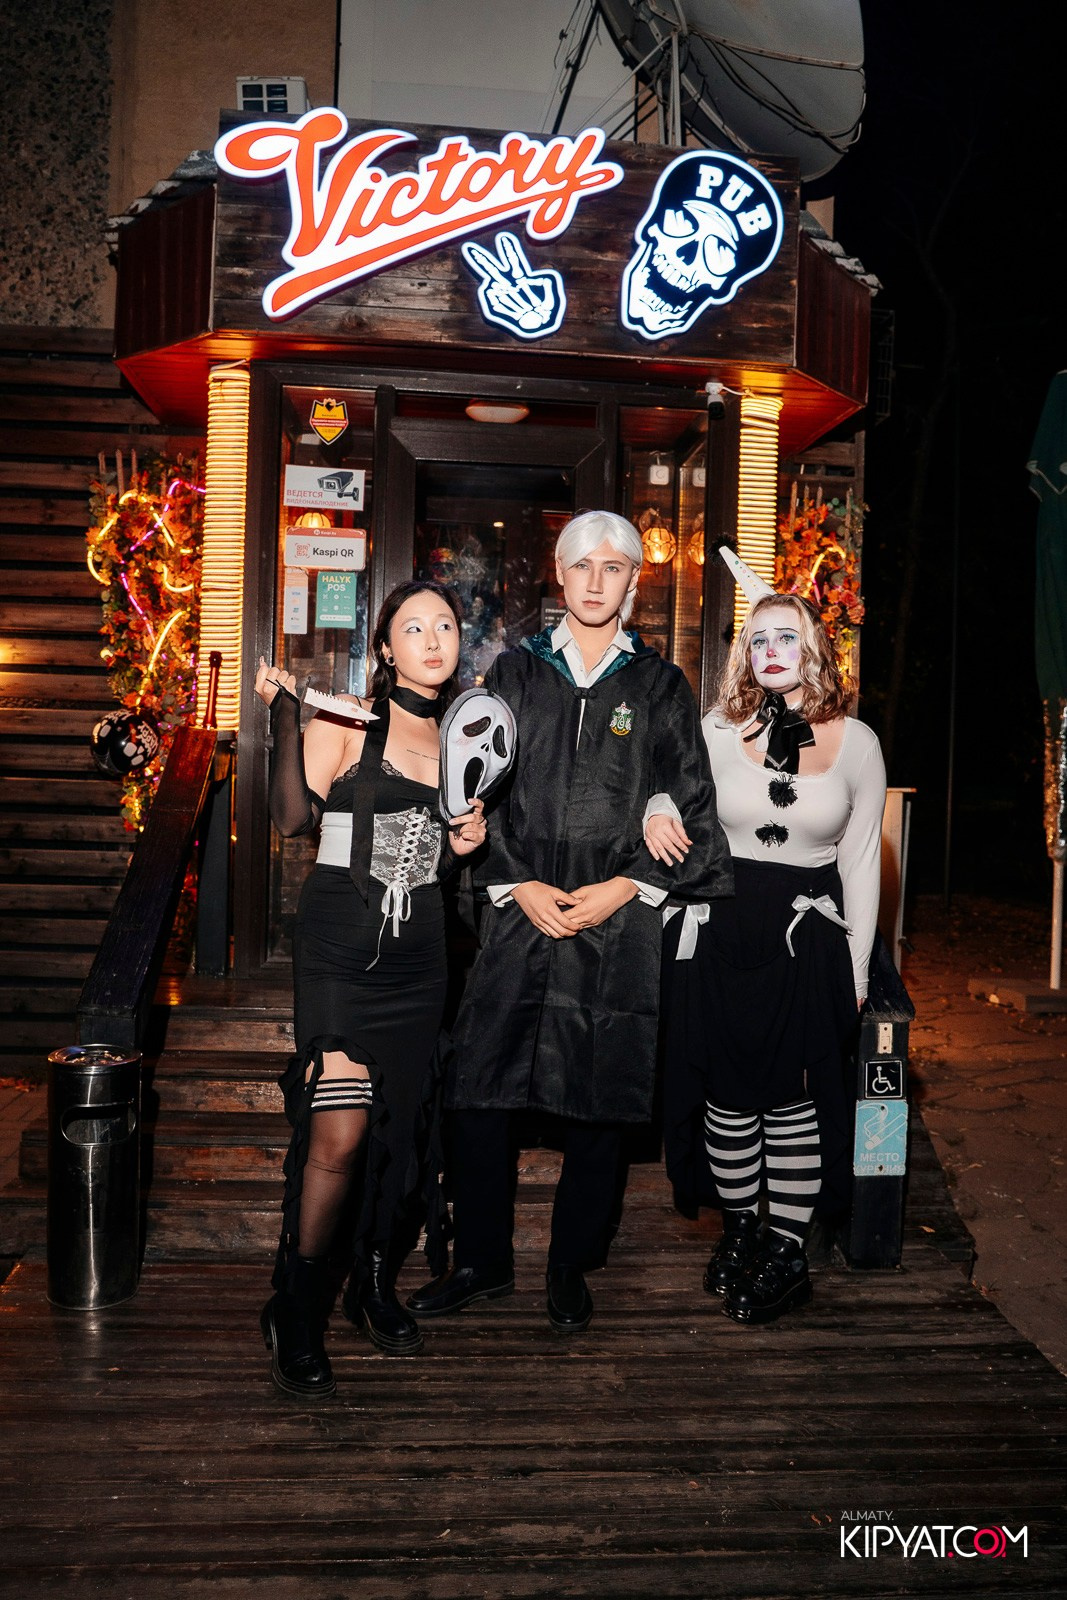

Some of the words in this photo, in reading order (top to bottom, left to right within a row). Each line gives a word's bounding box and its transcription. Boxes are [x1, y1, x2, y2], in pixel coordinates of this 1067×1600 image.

[696, 164, 774, 238] PUB
[220, 110, 619, 312] Victory
[286, 489, 323, 498] ВЕДЕТСЯ
[312, 547, 339, 558] Kaspi
[340, 548, 354, 558] QR
[321, 575, 351, 583] HALYK
[327, 583, 346, 592] POS
[860, 1152, 900, 1162] МЕСТО
